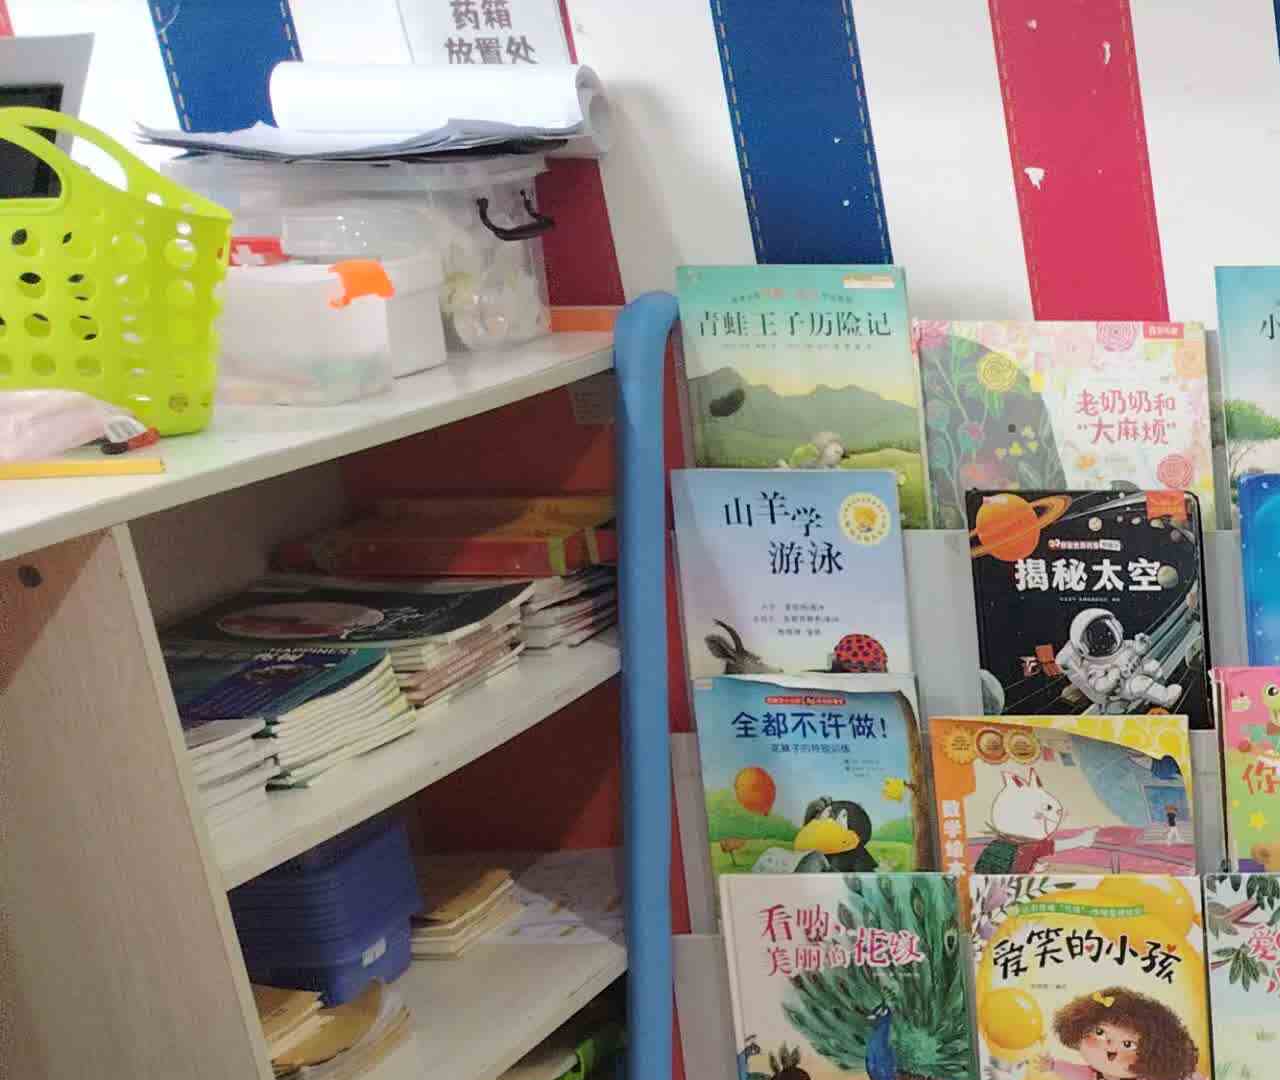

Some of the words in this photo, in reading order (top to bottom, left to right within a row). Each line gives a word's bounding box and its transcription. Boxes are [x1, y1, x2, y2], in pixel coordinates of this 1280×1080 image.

[443, 35, 540, 65] 放置处
[699, 310, 892, 337] 青蛙王子历险记
[1075, 388, 1177, 417] 老奶奶和
[724, 490, 823, 537] 山羊学
[768, 540, 844, 575] 游泳
[1014, 556, 1163, 592] 揭秘太空
[993, 926, 1182, 985] 爱笑的小孩
